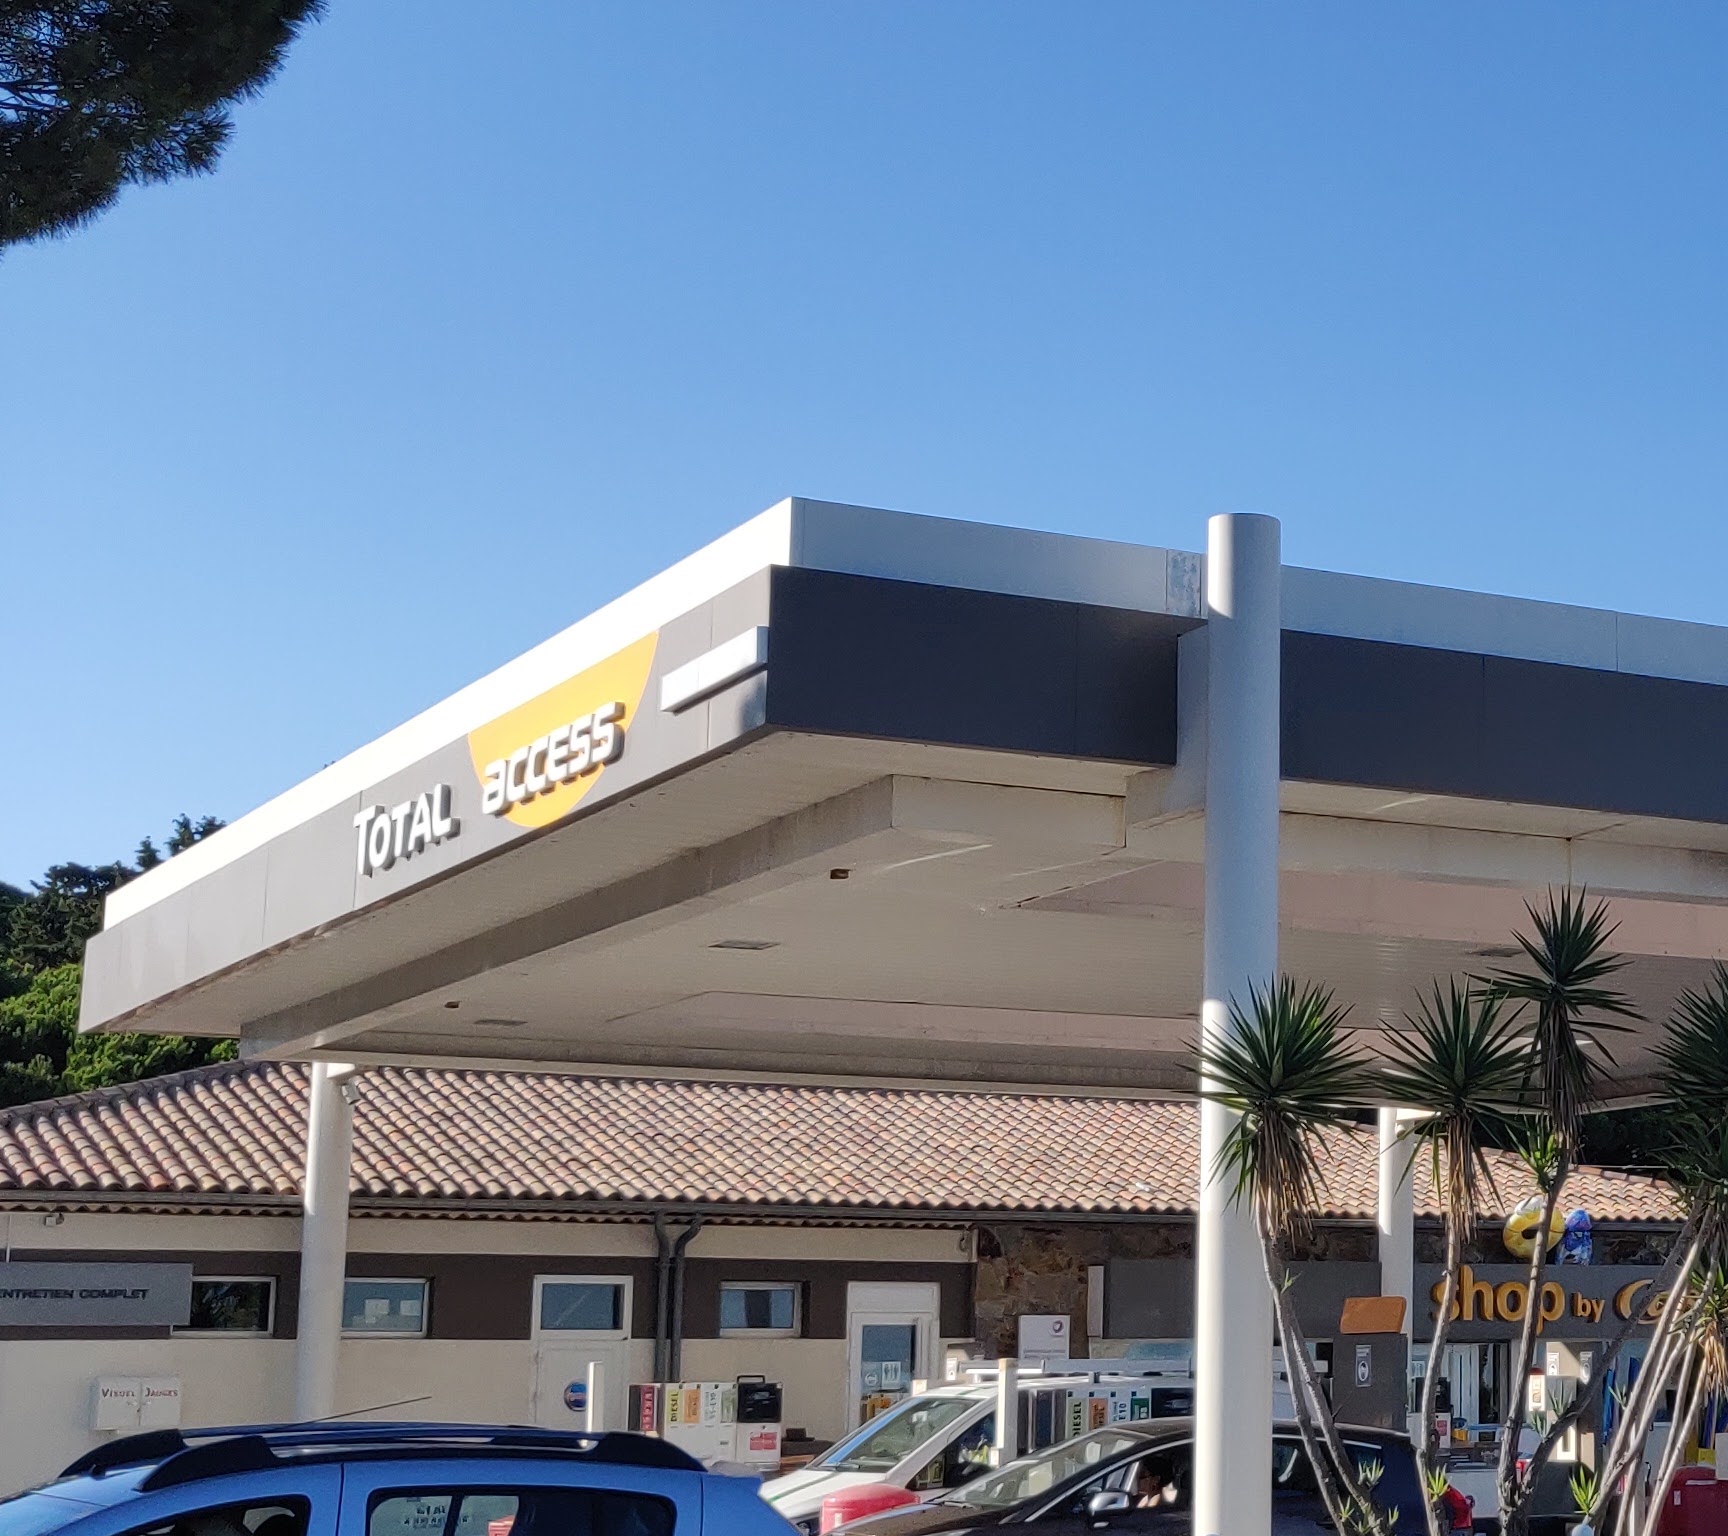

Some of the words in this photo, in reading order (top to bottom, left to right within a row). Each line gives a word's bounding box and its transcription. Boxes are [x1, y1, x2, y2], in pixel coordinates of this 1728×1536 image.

[353, 783, 460, 877] TOTAL
[1432, 1265, 1566, 1334] shop
[1573, 1292, 1606, 1323] by
